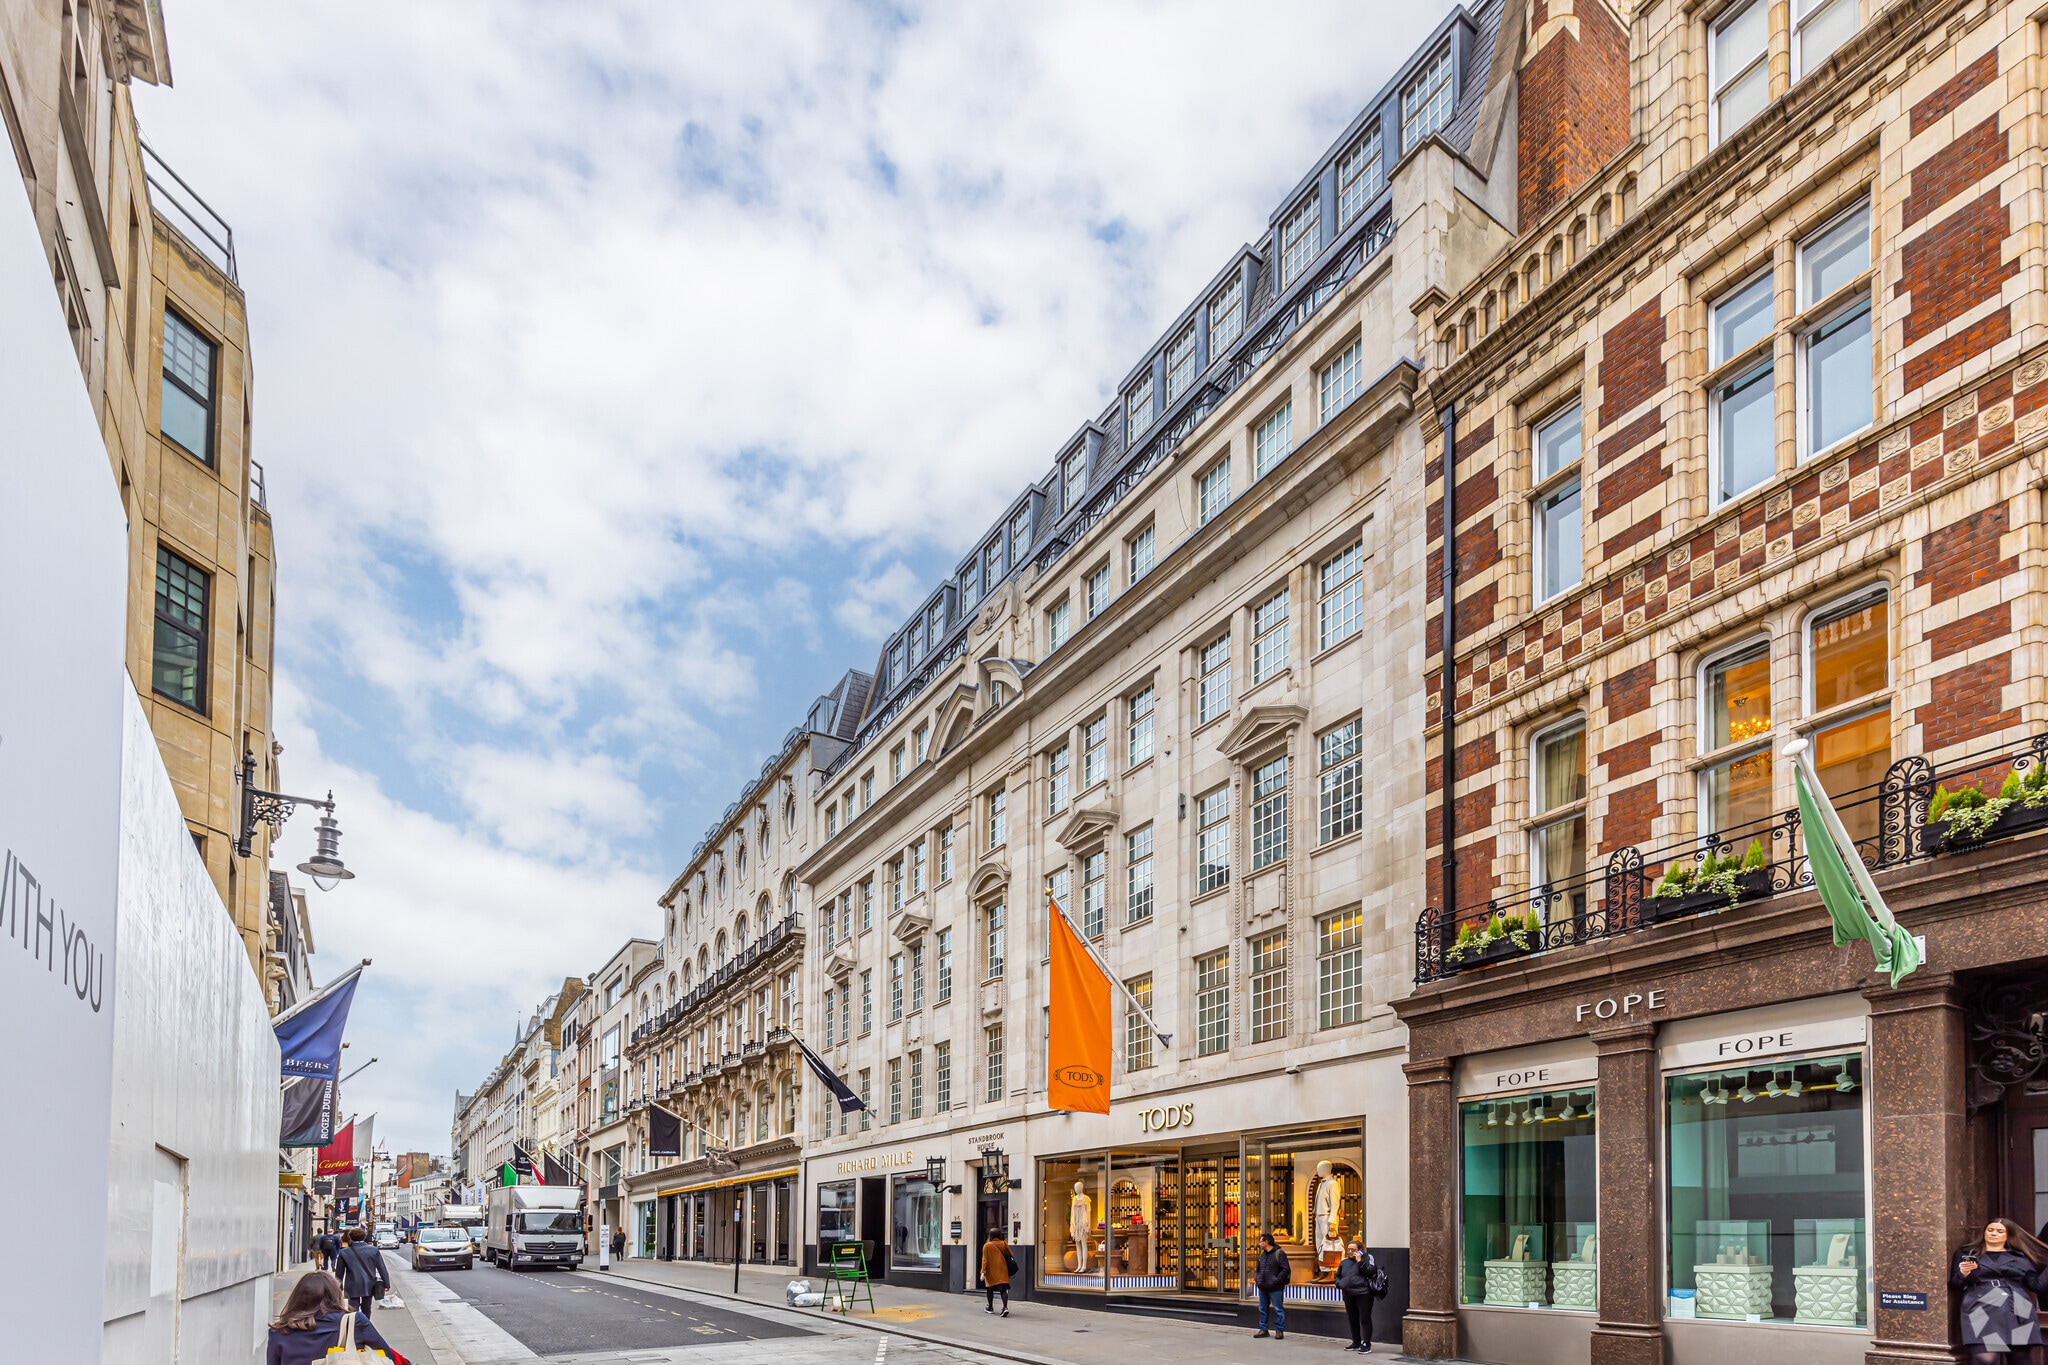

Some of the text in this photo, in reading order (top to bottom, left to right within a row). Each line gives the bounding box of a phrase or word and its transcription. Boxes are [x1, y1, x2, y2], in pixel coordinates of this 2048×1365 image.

[0, 848, 103, 1013] ITH YOU
[1576, 989, 1666, 1023] FOPE
[1719, 1032, 1793, 1056] FOPE
[286, 1059, 330, 1070] BEERS
[1067, 1071, 1094, 1083] TOD'S
[1497, 1069, 1549, 1087] FOPE
[321, 1111, 330, 1139] ROGER
[1138, 1103, 1193, 1133] TOD'S
[968, 1132, 1005, 1145] STANDBROOK
[318, 1159, 352, 1169] Cartier
[837, 1150, 913, 1175] RICHARD MILLE
